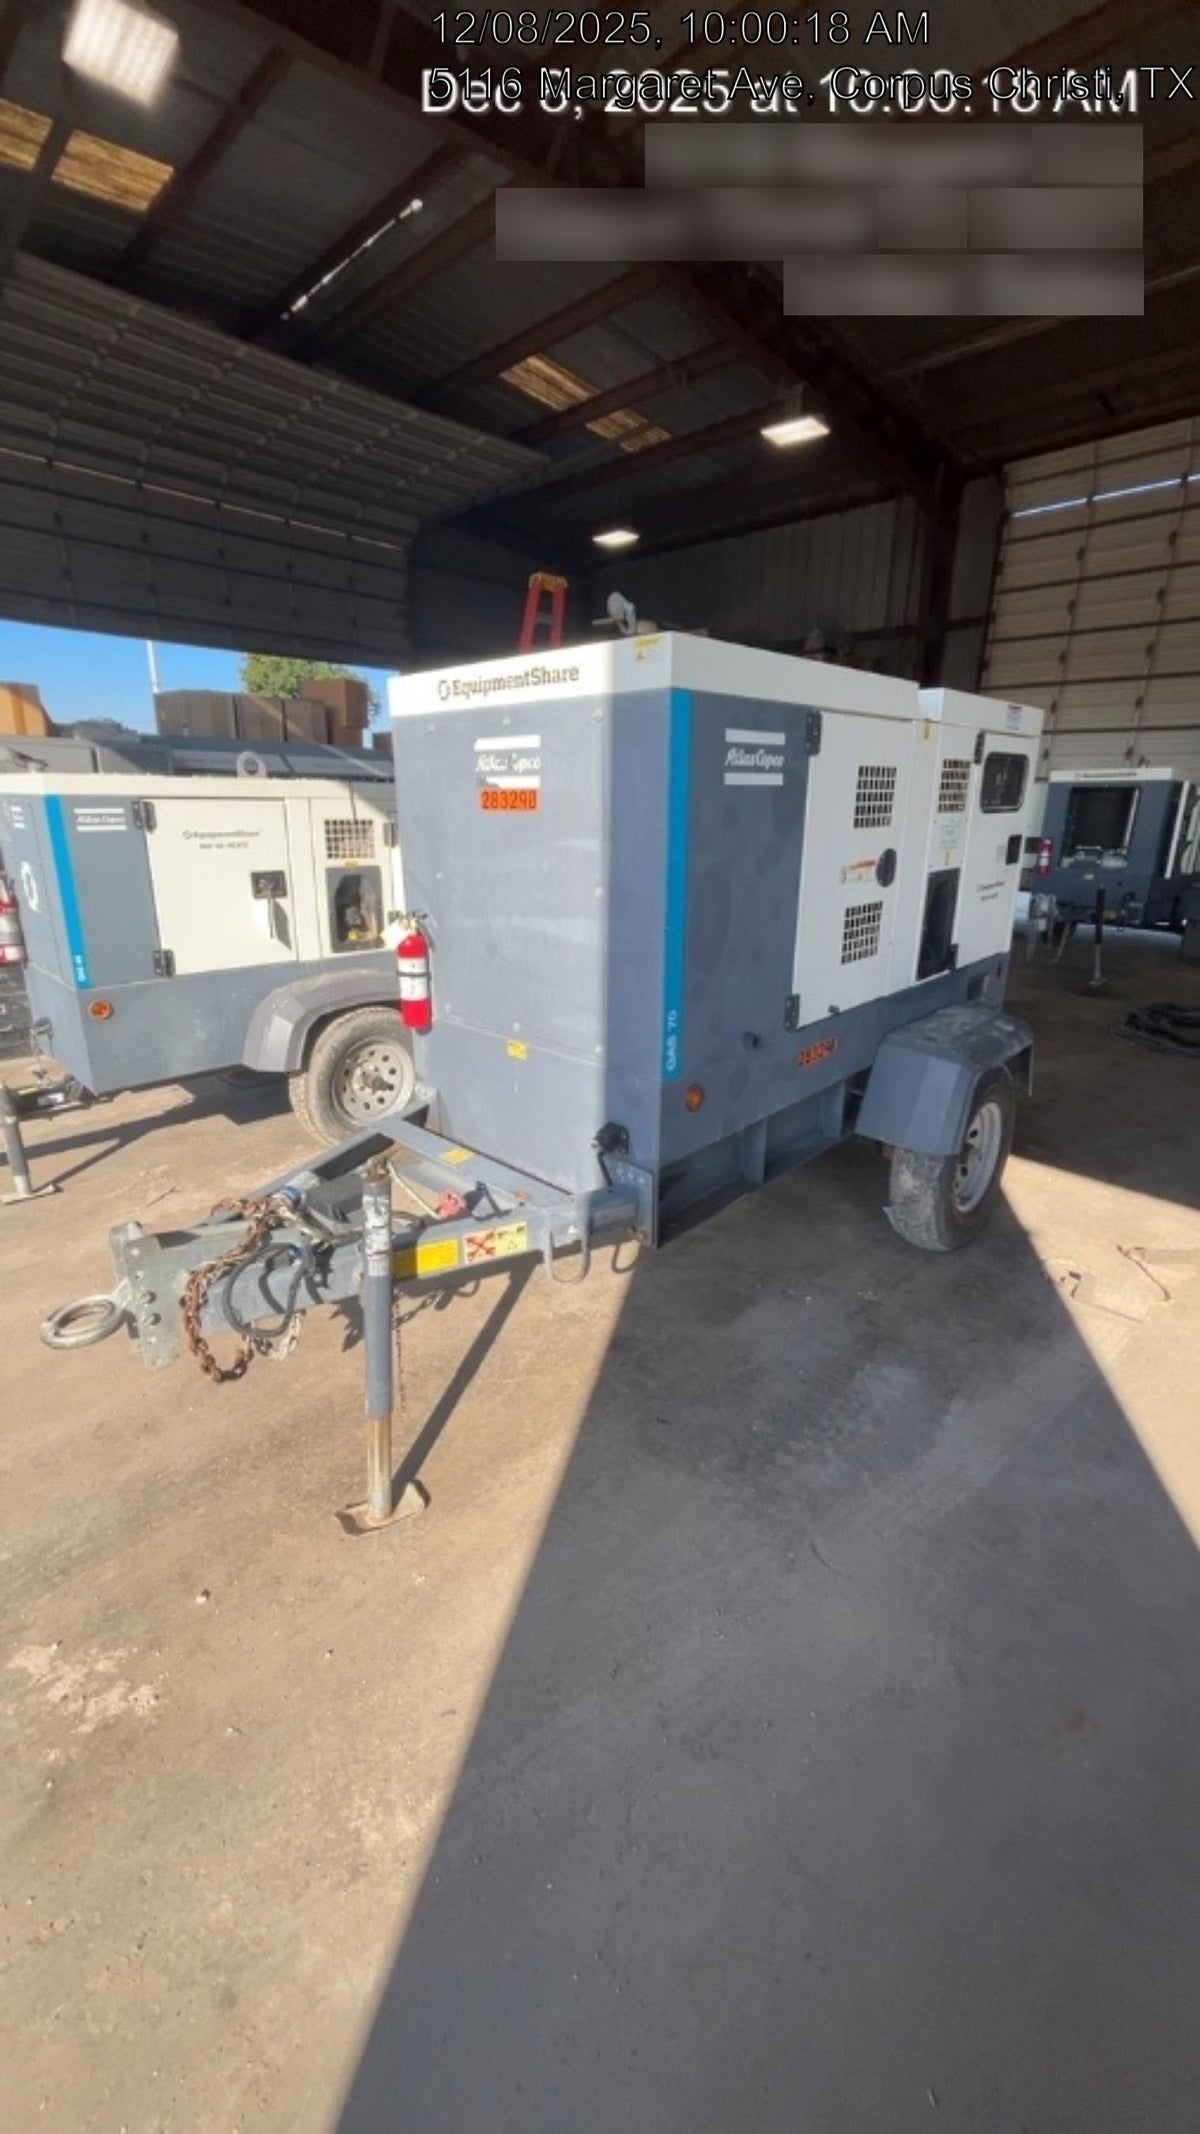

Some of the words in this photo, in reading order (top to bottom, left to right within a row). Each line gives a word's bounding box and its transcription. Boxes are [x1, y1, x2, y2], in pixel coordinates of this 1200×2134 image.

[452, 664, 580, 699] EquipmentShare
[724, 746, 755, 768] Atlas
[755, 748, 784, 772] Copco
[481, 789, 537, 810] 283290
